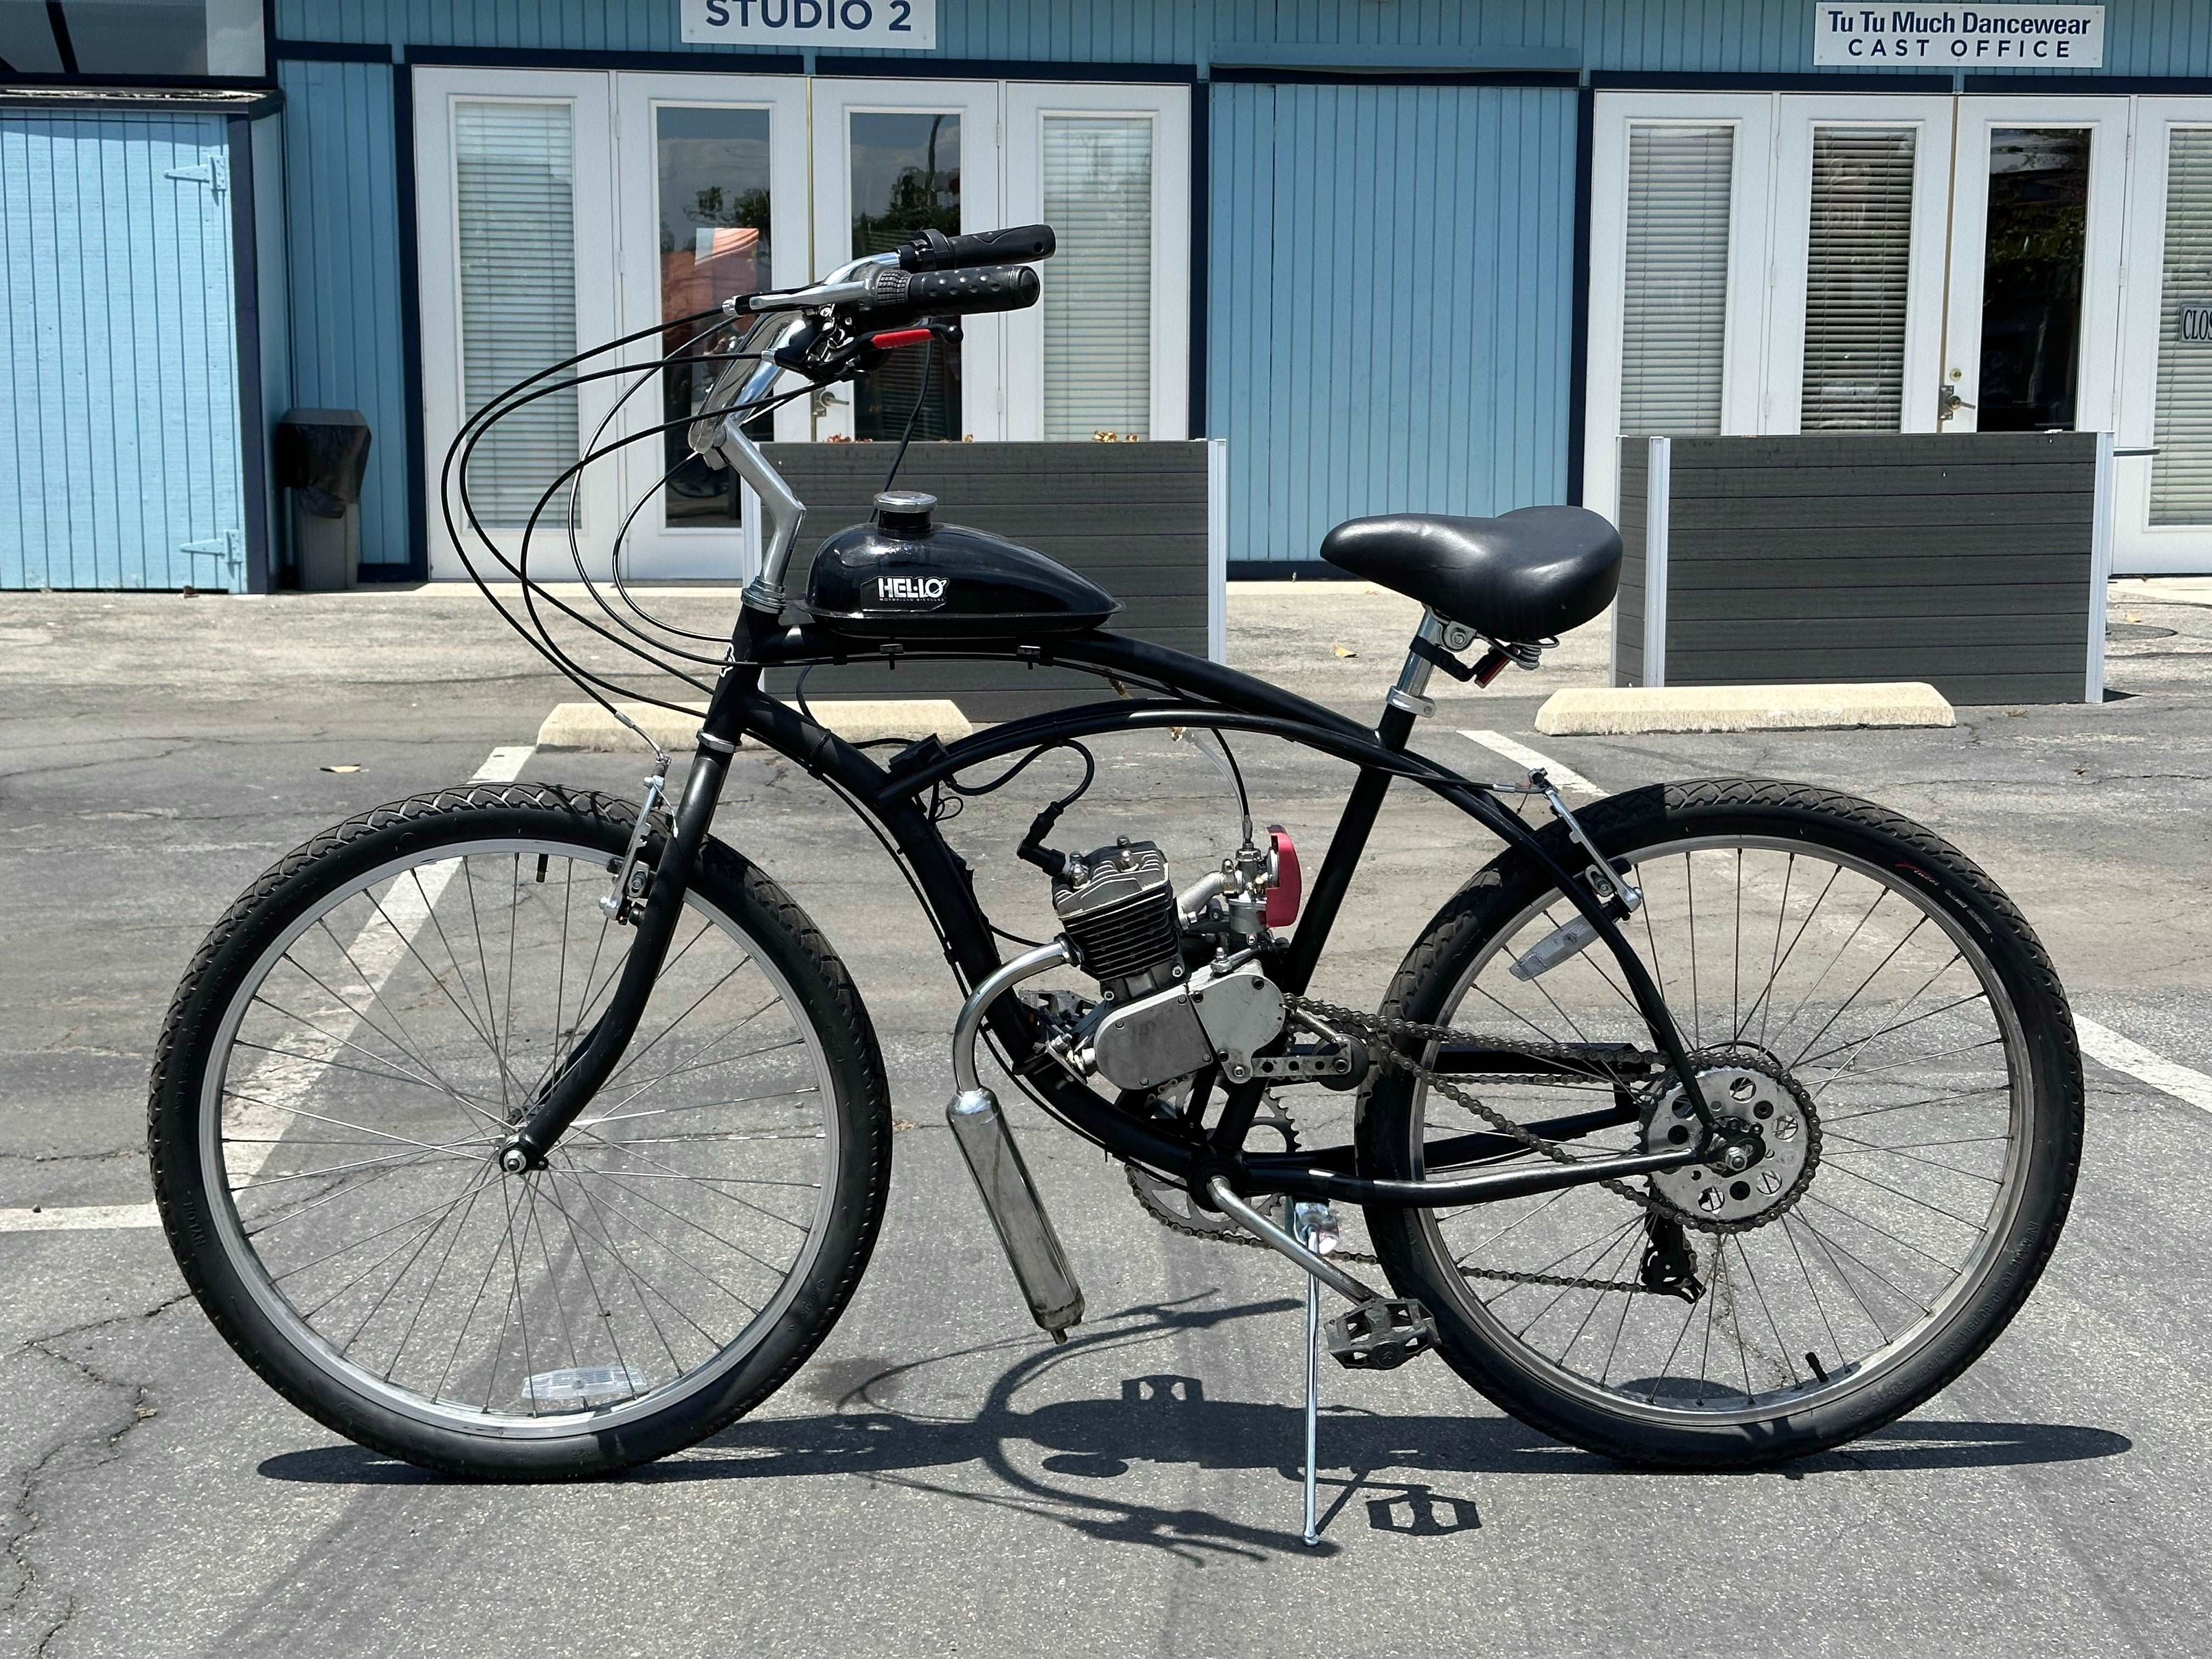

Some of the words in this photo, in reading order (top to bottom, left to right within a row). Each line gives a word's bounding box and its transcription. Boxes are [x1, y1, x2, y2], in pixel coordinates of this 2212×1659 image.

[705, 0, 873, 31] STUDIO
[888, 0, 912, 32] 2
[1828, 10, 1853, 33] Tu
[1859, 11, 1885, 33] Tu
[1892, 11, 1956, 34] Much
[1962, 12, 2092, 35] Dancewear
[1847, 39, 1930, 58] CAST
[1950, 39, 2070, 58] OFFICE
